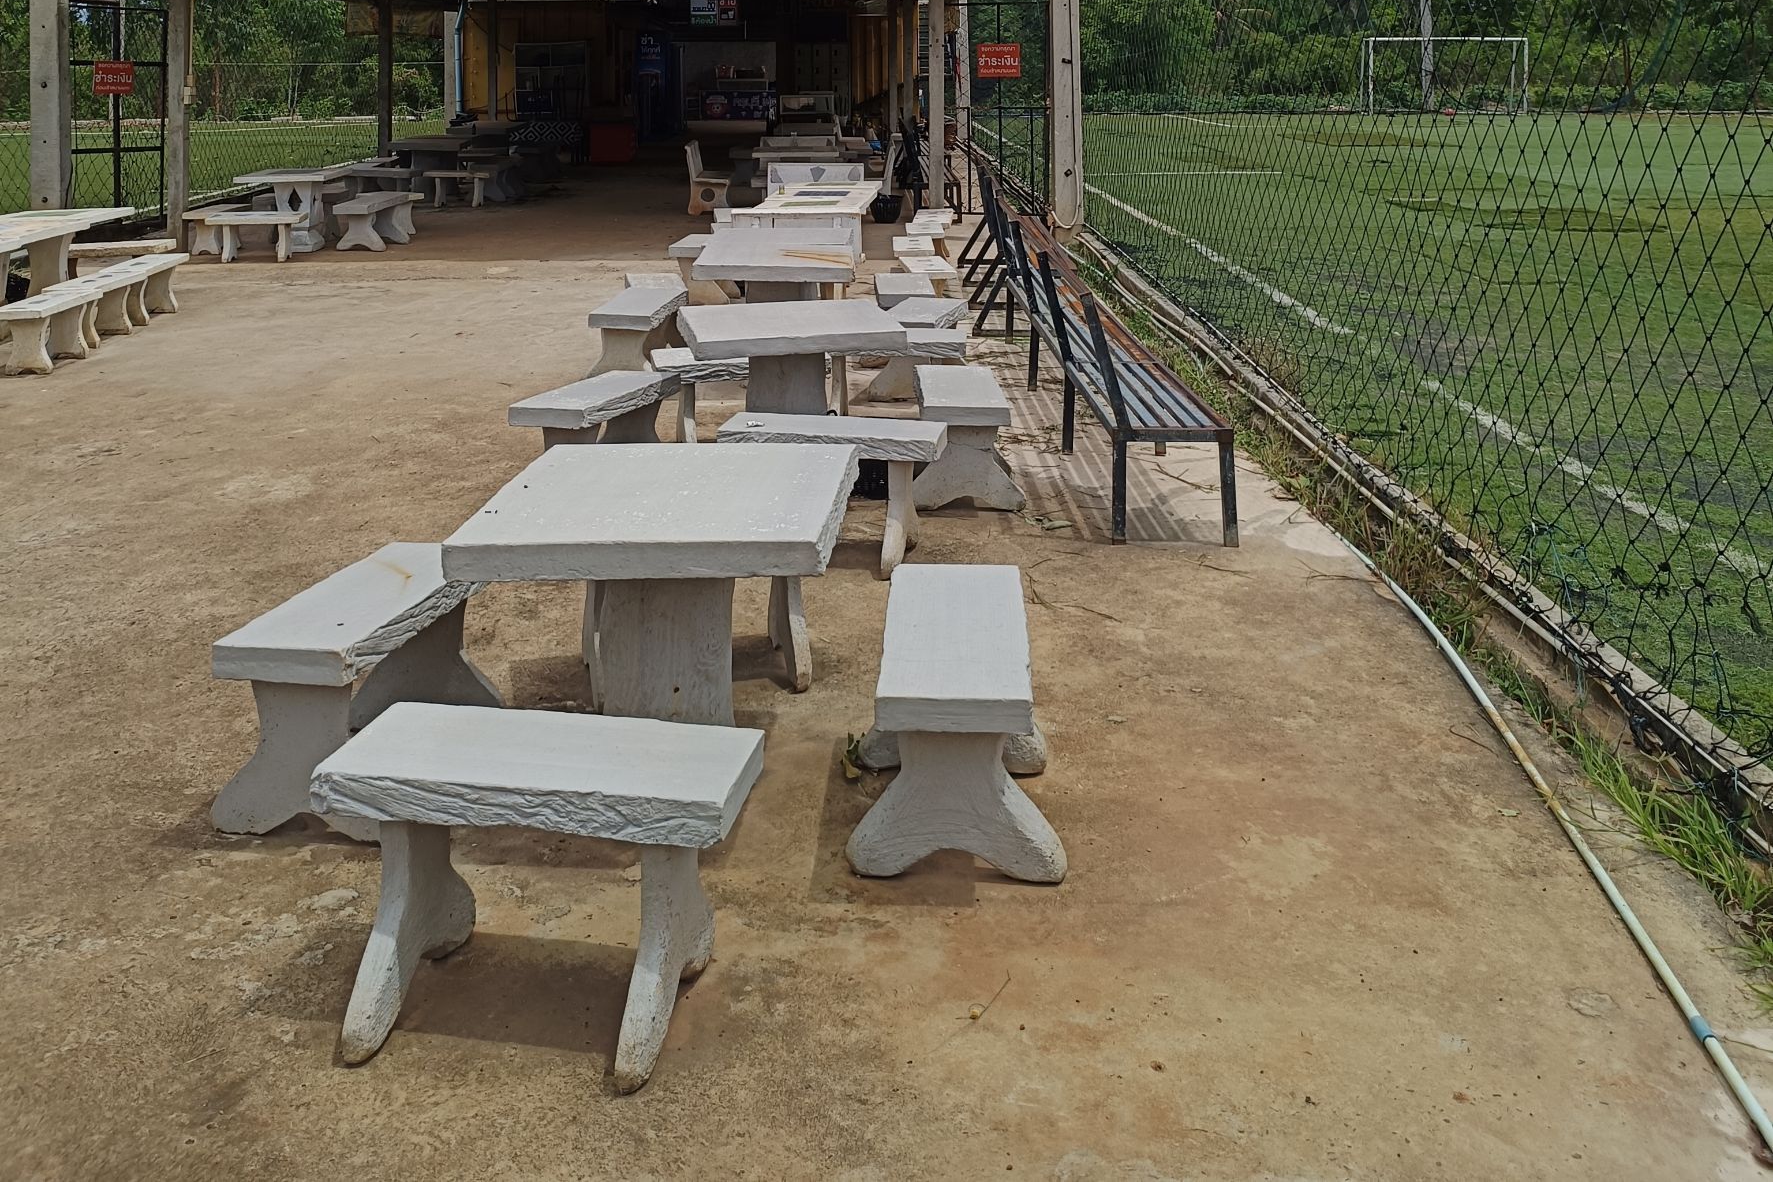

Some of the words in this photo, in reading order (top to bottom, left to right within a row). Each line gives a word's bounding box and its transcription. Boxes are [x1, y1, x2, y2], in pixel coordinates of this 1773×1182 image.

[978, 54, 1018, 66] ชำระเงิน
[94, 70, 133, 83] ชำระเงิน
